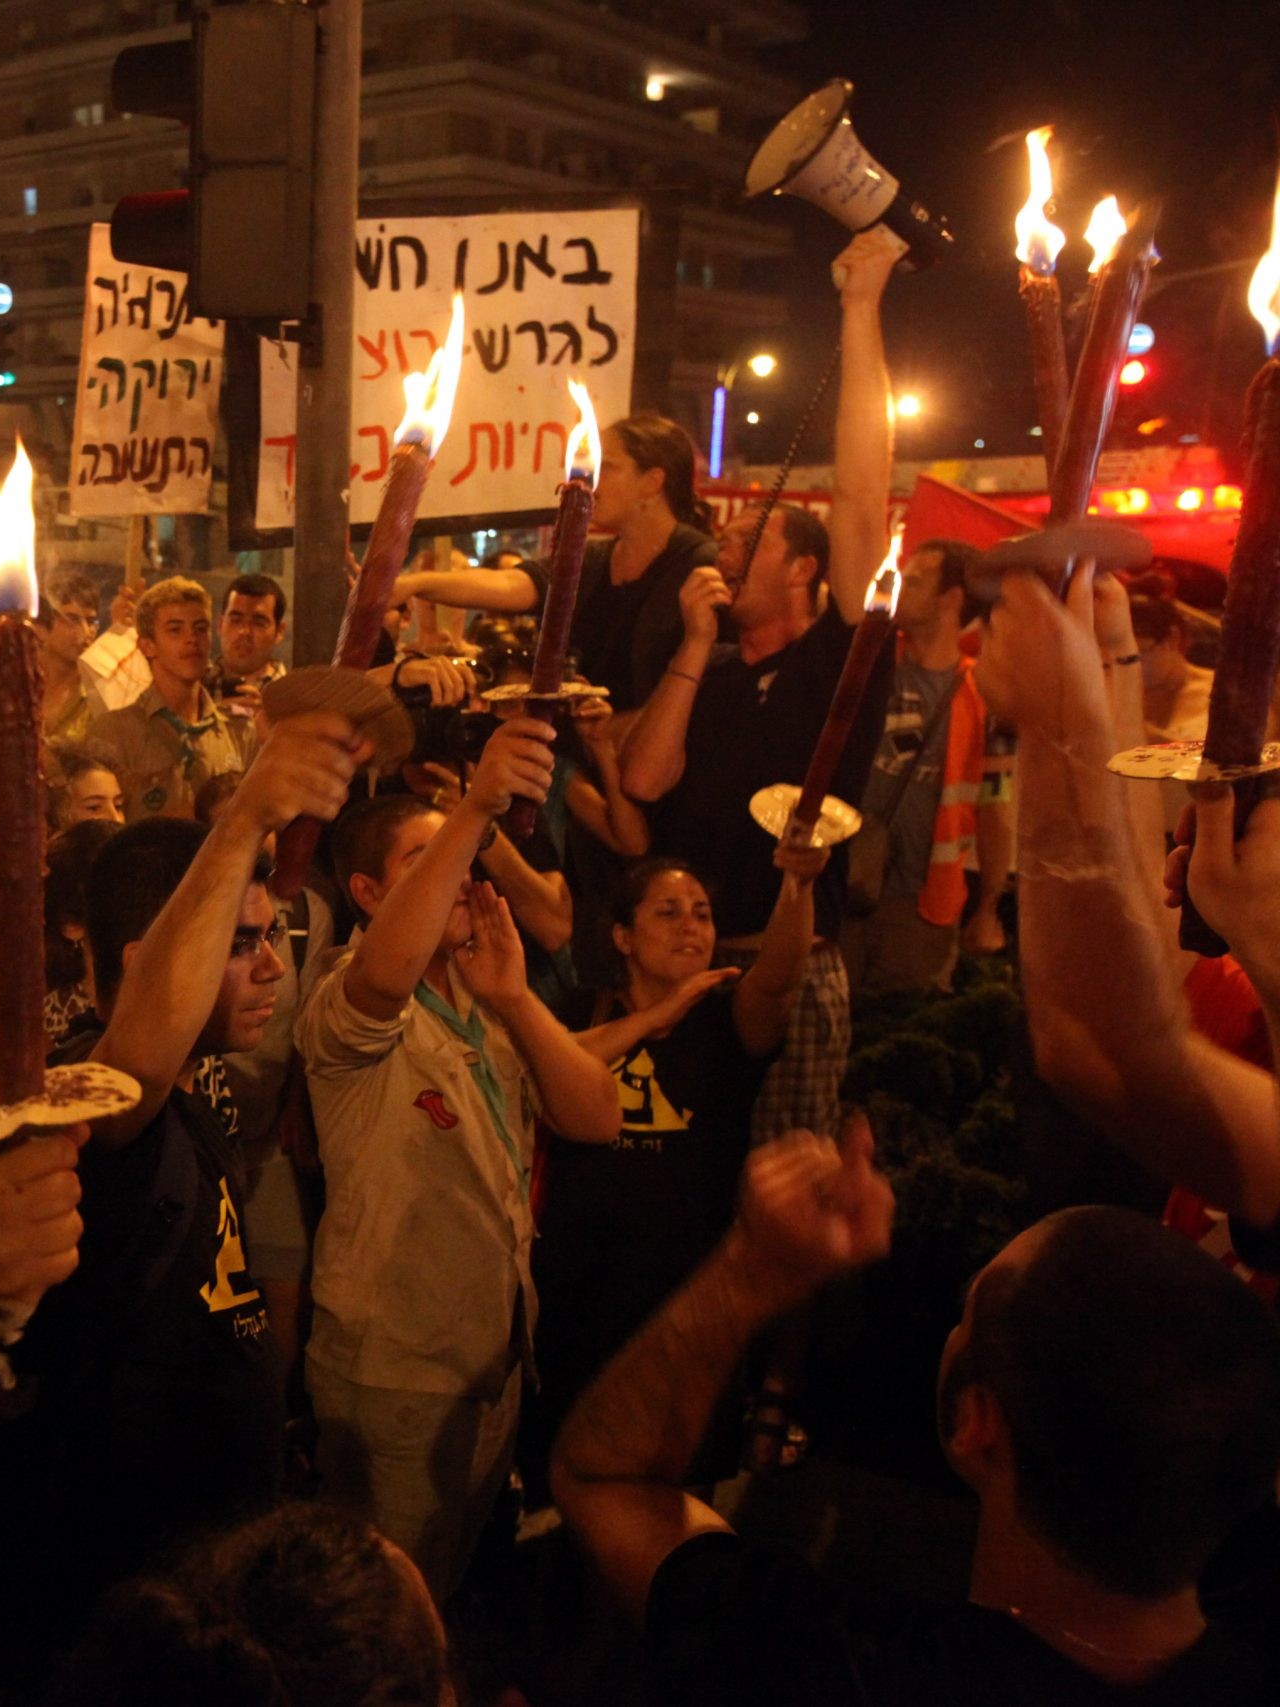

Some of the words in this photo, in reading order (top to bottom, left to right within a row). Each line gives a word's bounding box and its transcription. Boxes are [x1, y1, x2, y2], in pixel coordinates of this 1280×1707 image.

[354, 224, 428, 291] חש
[455, 234, 613, 295] באנו
[357, 328, 440, 380] רוצ
[449, 418, 579, 487] חיות
